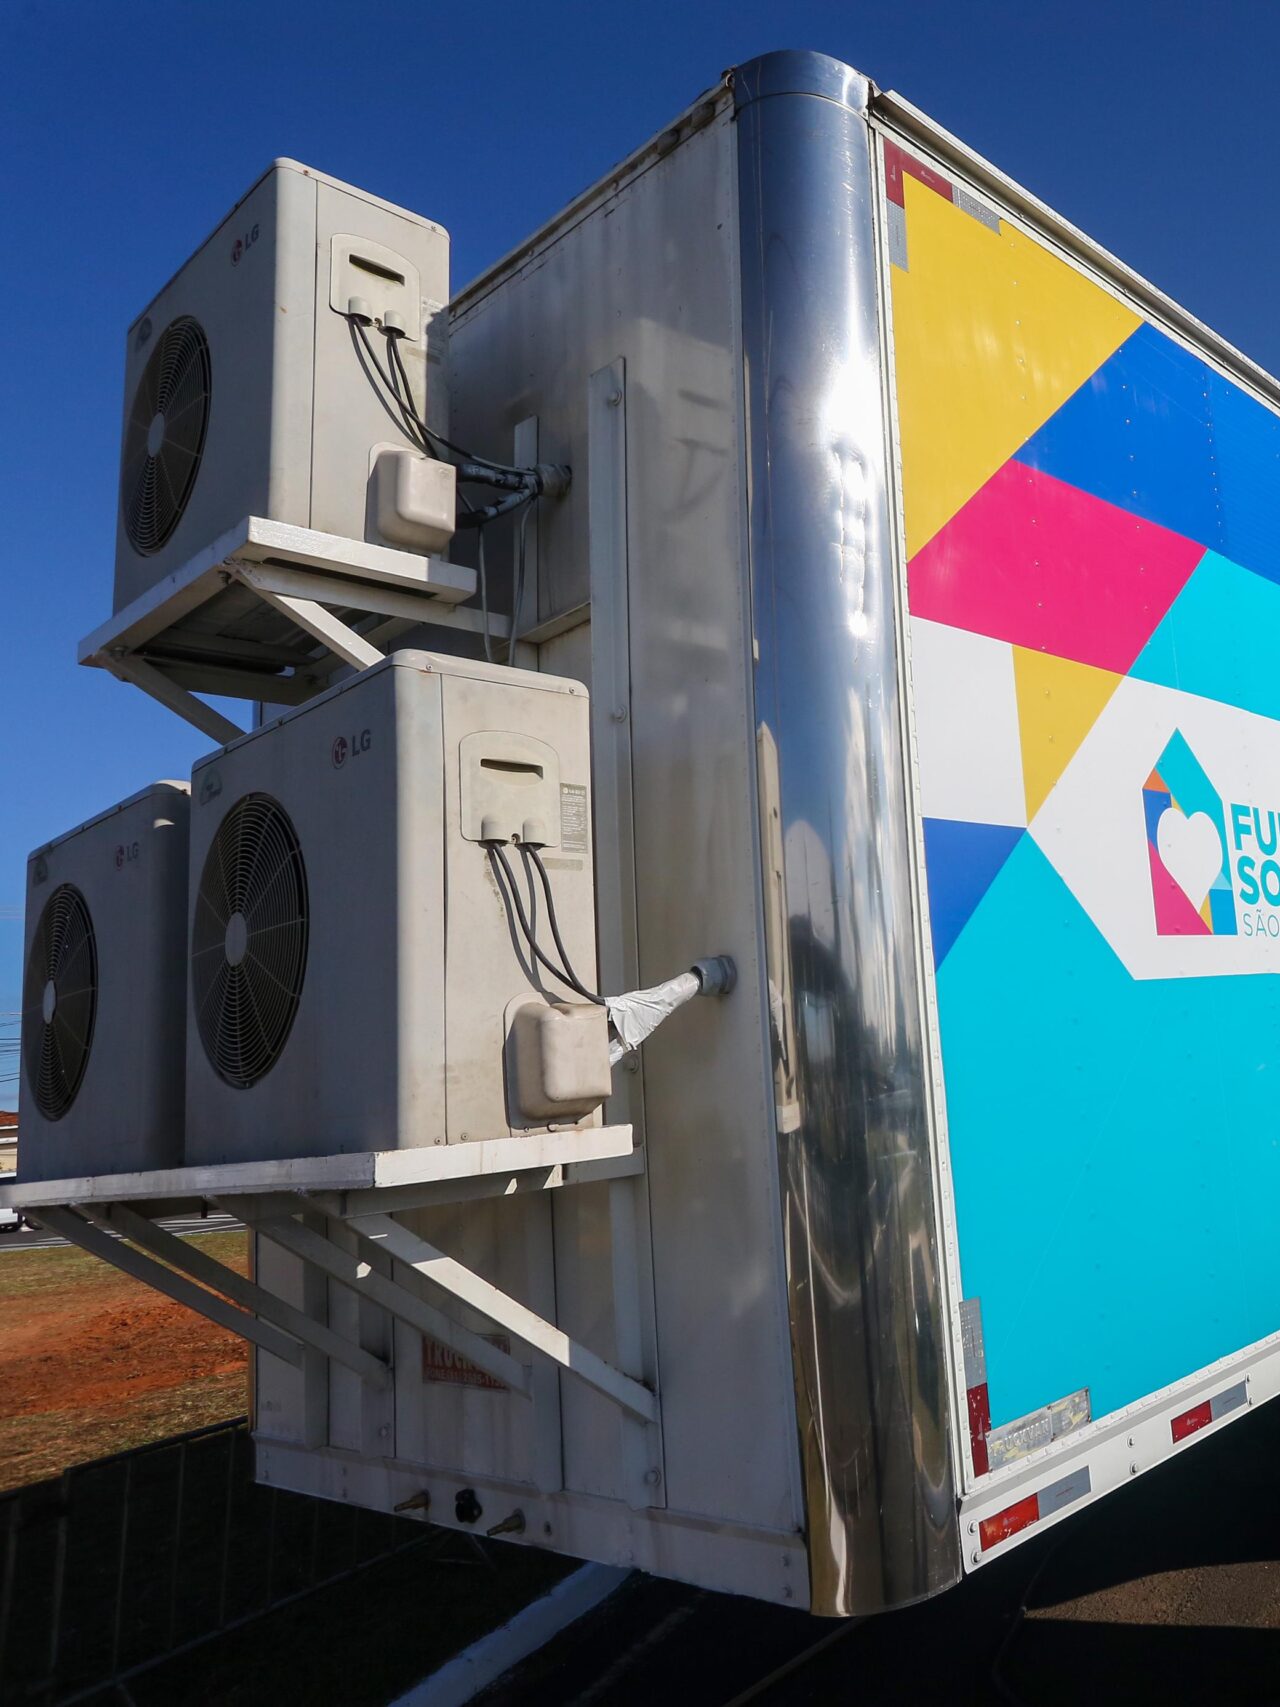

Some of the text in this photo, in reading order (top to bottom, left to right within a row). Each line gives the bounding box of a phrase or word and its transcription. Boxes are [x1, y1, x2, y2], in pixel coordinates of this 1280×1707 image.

[245, 223, 259, 250] LG
[351, 728, 372, 757] LG
[126, 841, 140, 861] LG
[1243, 908, 1280, 938] SÃO
